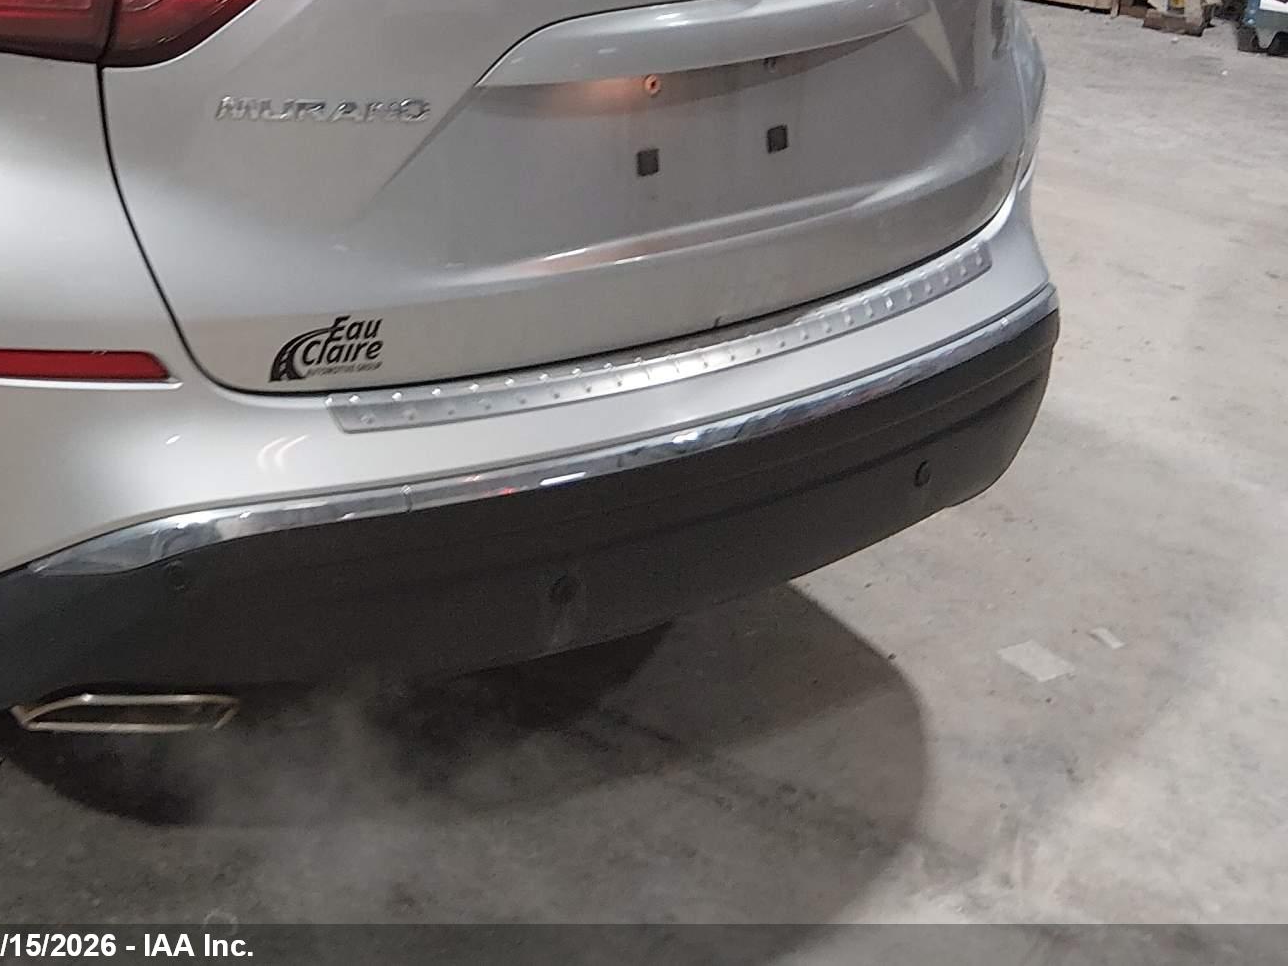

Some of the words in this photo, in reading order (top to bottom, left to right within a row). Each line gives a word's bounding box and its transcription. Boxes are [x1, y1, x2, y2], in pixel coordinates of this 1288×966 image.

[216, 95, 431, 124] MURANO
[327, 315, 383, 343] Eau
[302, 338, 384, 366] Claire
